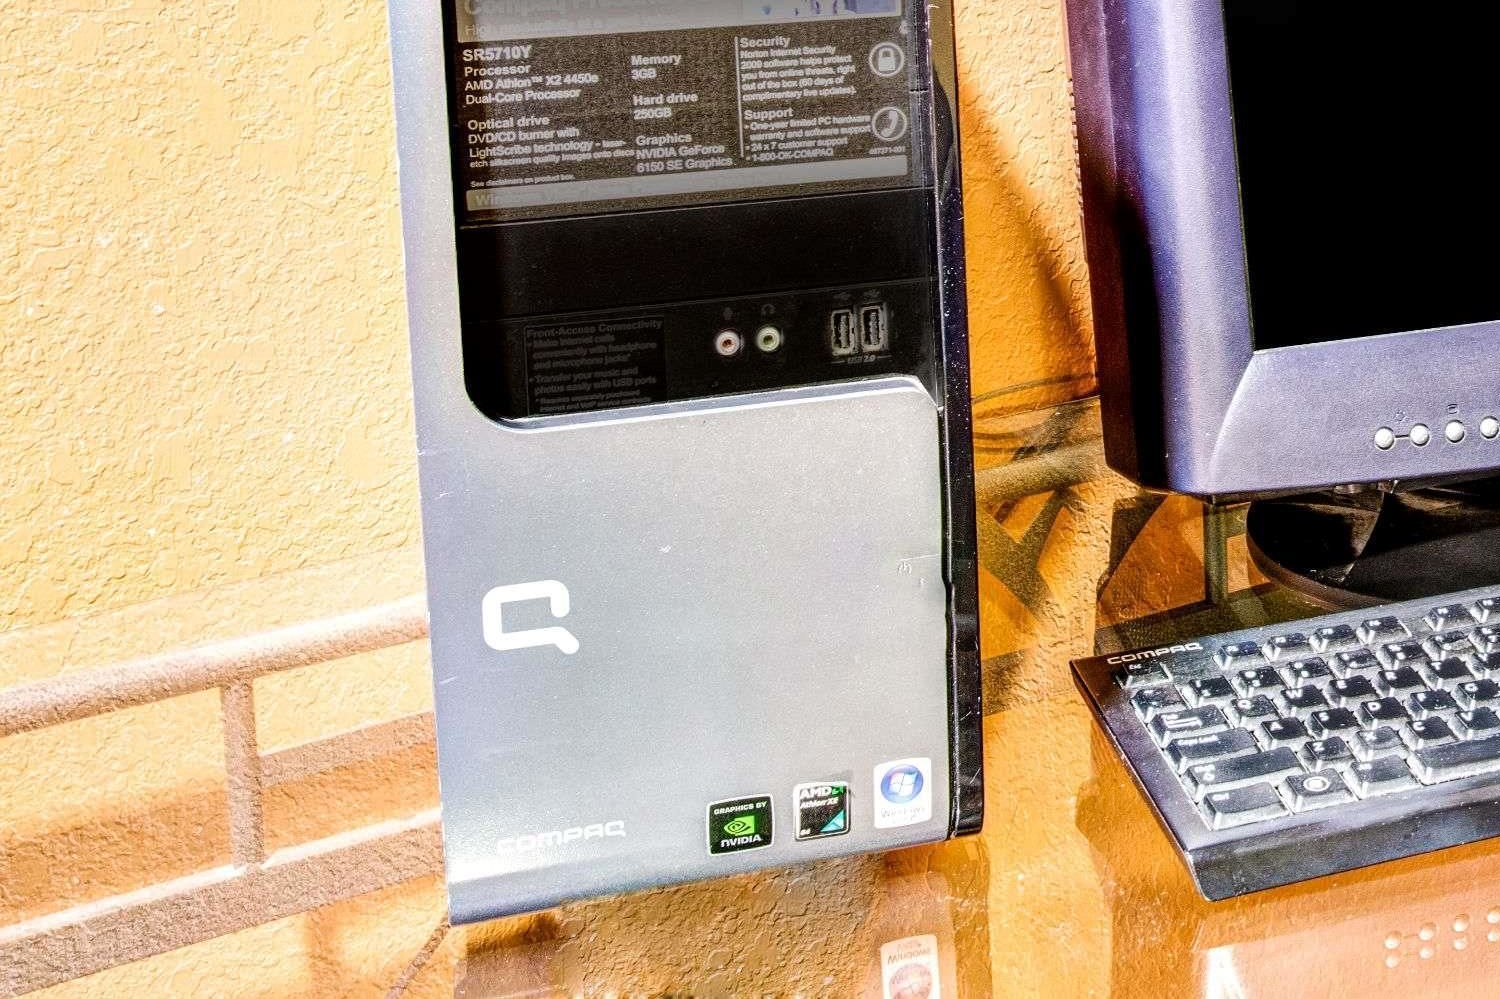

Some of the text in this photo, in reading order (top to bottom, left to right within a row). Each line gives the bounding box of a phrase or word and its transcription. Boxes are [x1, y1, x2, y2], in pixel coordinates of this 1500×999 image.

[740, 35, 791, 48] Security
[462, 44, 532, 62] SR5710Y
[630, 54, 682, 66] Memory
[740, 45, 836, 59] Norton Internet Security
[763, 58, 800, 68] software
[800, 56, 823, 66] helps
[823, 54, 853, 65] protect
[464, 65, 532, 77] Processor
[631, 67, 657, 80] 3GB
[741, 72, 758, 82] you
[758, 70, 778, 79] from
[779, 68, 804, 78] online
[837, 64, 857, 75] right
[465, 79, 494, 91] AMD
[545, 74, 562, 86] X2
[563, 72, 600, 85] 4450e
[741, 82, 757, 92] out
[757, 81, 767, 90] of
[767, 79, 781, 89] the
[814, 76, 835, 87] days
[835, 75, 846, 85] of
[465, 88, 582, 105] Dual-Core Processor
[633, 92, 699, 106] Hard drive
[633, 107, 672, 120] 250GB
[744, 107, 795, 122] Support
[789, 119, 817, 128] limited
[818, 116, 832, 126] PC
[832, 114, 871, 124] hardware
[467, 116, 550, 132] Optical drive
[468, 126, 580, 144] DVD/CD burner with
[635, 132, 693, 146] Graphics
[750, 125, 872, 142] warranty and software support
[469, 144, 532, 159] LightScribe
[534, 139, 593, 154] technology
[636, 144, 725, 160] NVIDIA GeForce
[751, 143, 763, 152] 24
[778, 138, 817, 150] customer
[817, 136, 849, 148] support
[469, 159, 489, 168] etch
[533, 154, 560, 164] quality
[613, 147, 635, 157] discs
[636, 156, 733, 173] 6150 SE Graphics
[598, 319, 662, 332] Connectivity
[572, 371, 593, 383] your
[612, 377, 633, 387] USB
[635, 375, 657, 387] ports
[1107, 642, 1203, 665] COMPAQ
[1286, 689, 1303, 698] W
[1336, 680, 1347, 689] E
[1385, 671, 1397, 680] R
[1431, 661, 1442, 670] T
[1270, 721, 1284, 731] A
[1318, 712, 1330, 722] S
[1367, 701, 1381, 711] D
[1464, 683, 1478, 693] G
[1313, 742, 1325, 752] Z
[1365, 731, 1377, 741] X
[1412, 721, 1425, 731] C
[1460, 711, 1473, 722] V
[800, 786, 832, 800] AMD
[714, 801, 767, 815] GRAPHICS BY
[498, 820, 626, 851] COMPAQ
